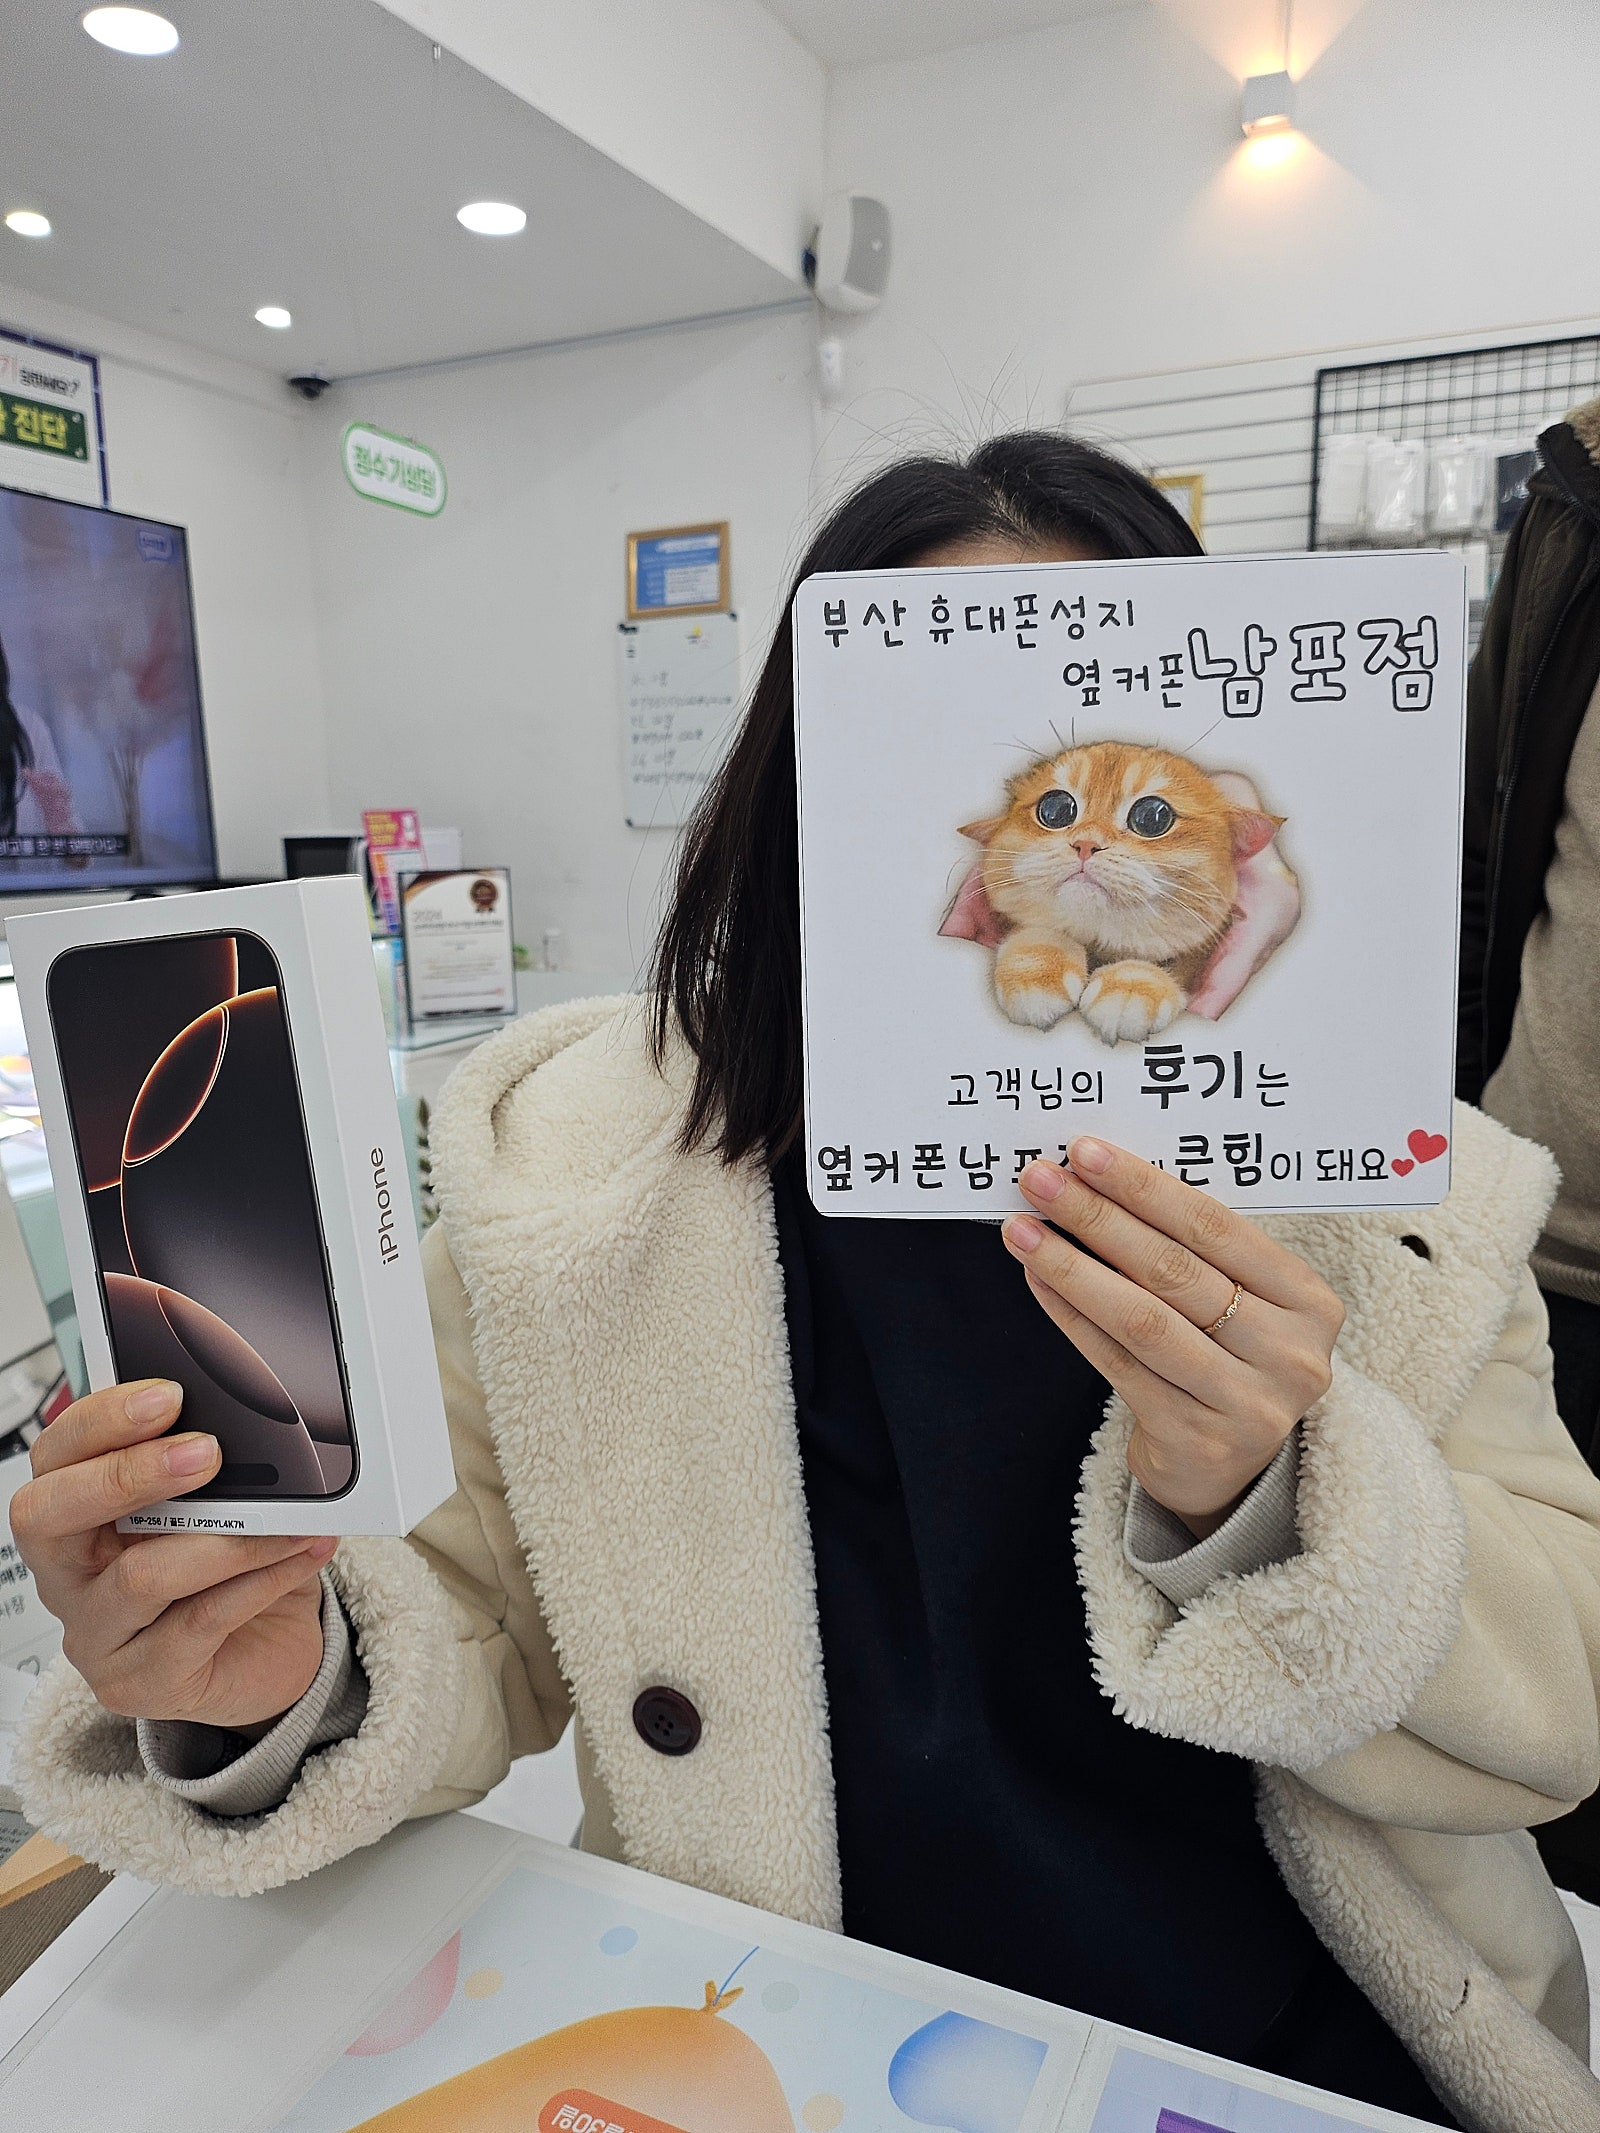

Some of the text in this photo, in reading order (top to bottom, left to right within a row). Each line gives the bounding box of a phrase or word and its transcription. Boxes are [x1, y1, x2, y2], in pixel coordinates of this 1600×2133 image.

[12, 402, 68, 449] 진단
[824, 594, 1135, 650] 부산 휴대폰성지
[1063, 615, 1440, 719] 옆커폰 남포점
[947, 1045, 1290, 1111] 고객님의 후기는
[1316, 1149, 1391, 1183] 돼요
[370, 1147, 399, 1266] iPhone
[170, 1517, 185, 1527] 골드
[193, 1518, 245, 1529] LP2DYL4K7N
